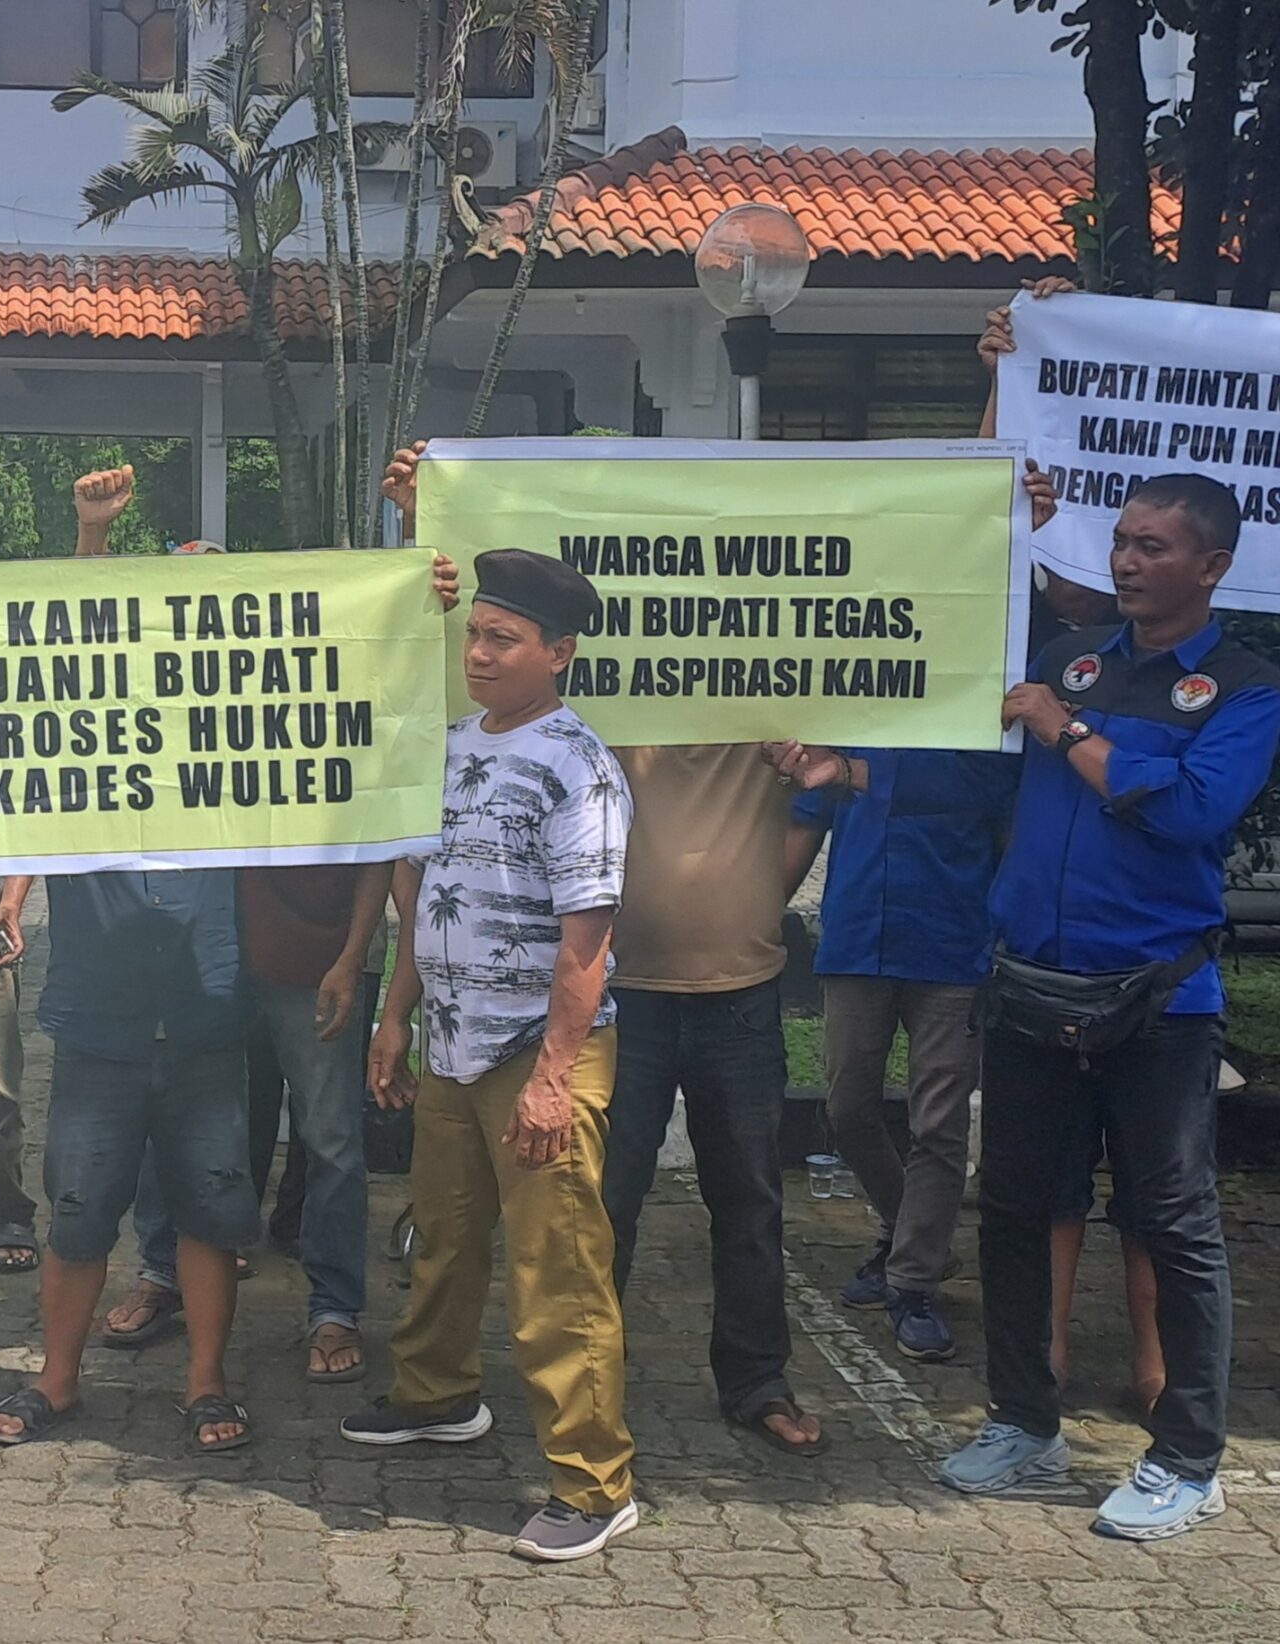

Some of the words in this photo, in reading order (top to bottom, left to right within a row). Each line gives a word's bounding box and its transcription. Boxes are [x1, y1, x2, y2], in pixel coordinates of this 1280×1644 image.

[1038, 358, 1149, 402] BUPATI
[1155, 367, 1259, 411] MINTA
[1079, 416, 1162, 458] KAMI
[1167, 423, 1237, 465] PUN
[1048, 464, 1144, 510] DENGA
[559, 535, 705, 577] WARGA
[715, 536, 851, 577] WULED
[7, 597, 141, 647] KAMI
[165, 591, 320, 641] TAGIH
[642, 597, 779, 638] BUPATI
[790, 597, 922, 643] TEGAS,
[154, 646, 339, 698] BUPATI
[629, 657, 812, 698] ASPIRASI
[822, 659, 927, 699] KAMI
[189, 700, 373, 752] HUKUM
[178, 757, 353, 809] WULED
